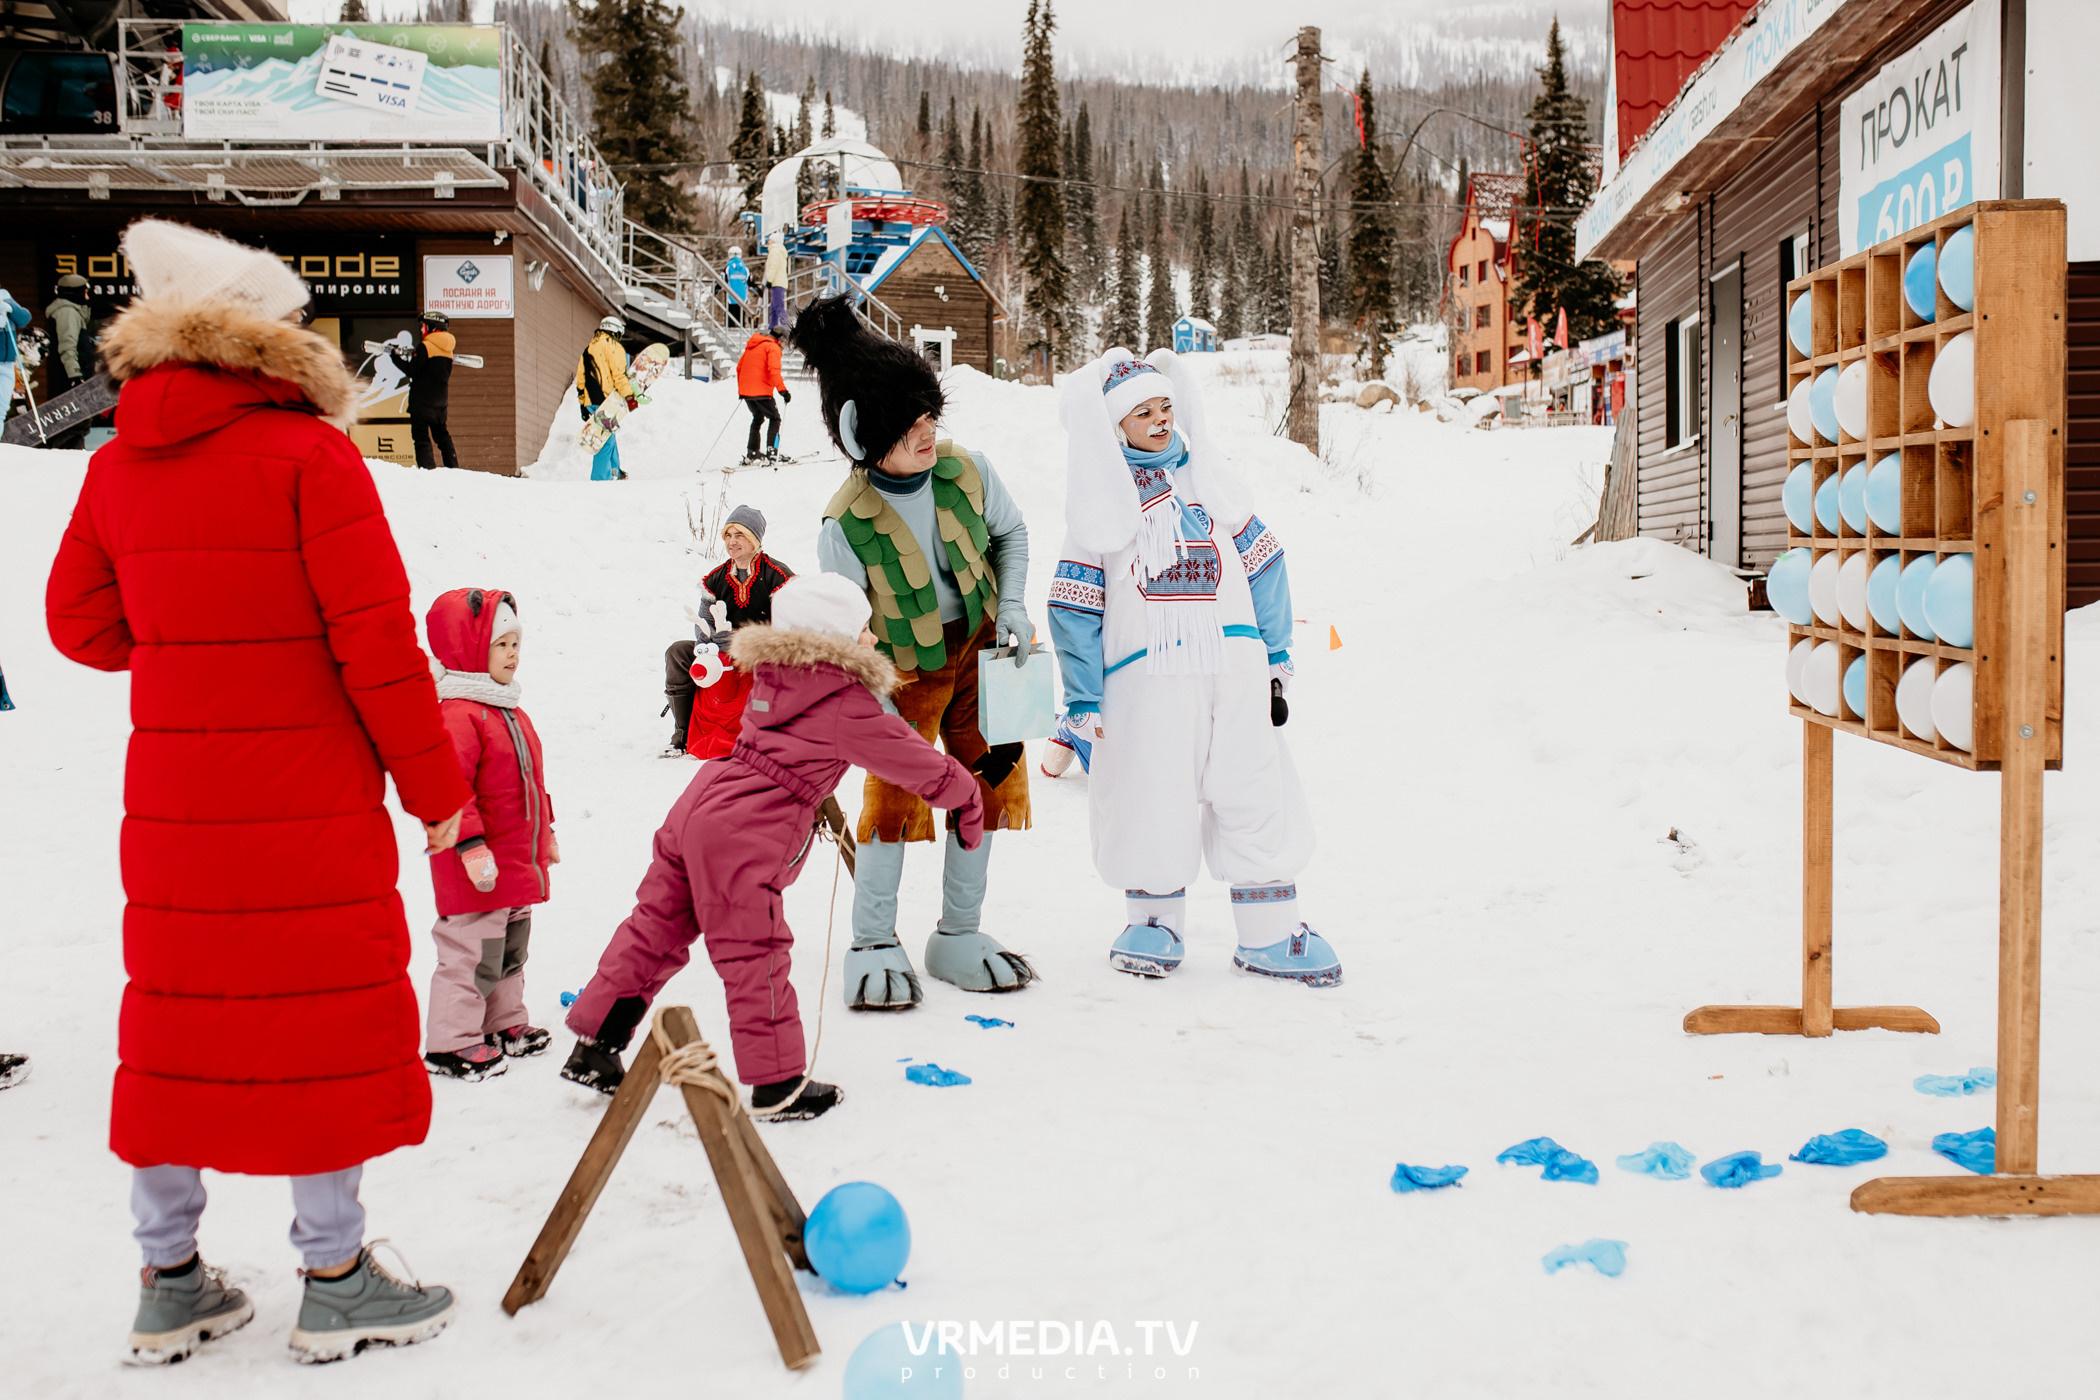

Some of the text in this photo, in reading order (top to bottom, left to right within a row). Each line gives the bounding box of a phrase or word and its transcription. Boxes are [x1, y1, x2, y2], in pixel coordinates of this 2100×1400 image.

[1743, 0, 1797, 83] ПРОКАТ
[378, 92, 406, 108] VISA
[1860, 41, 1968, 171] ПРОКАТ
[93, 110, 113, 125] 38
[443, 288, 496, 298] ПОСАДКА НА
[429, 300, 510, 310] КАНАТНУЮ ДОРОГУ
